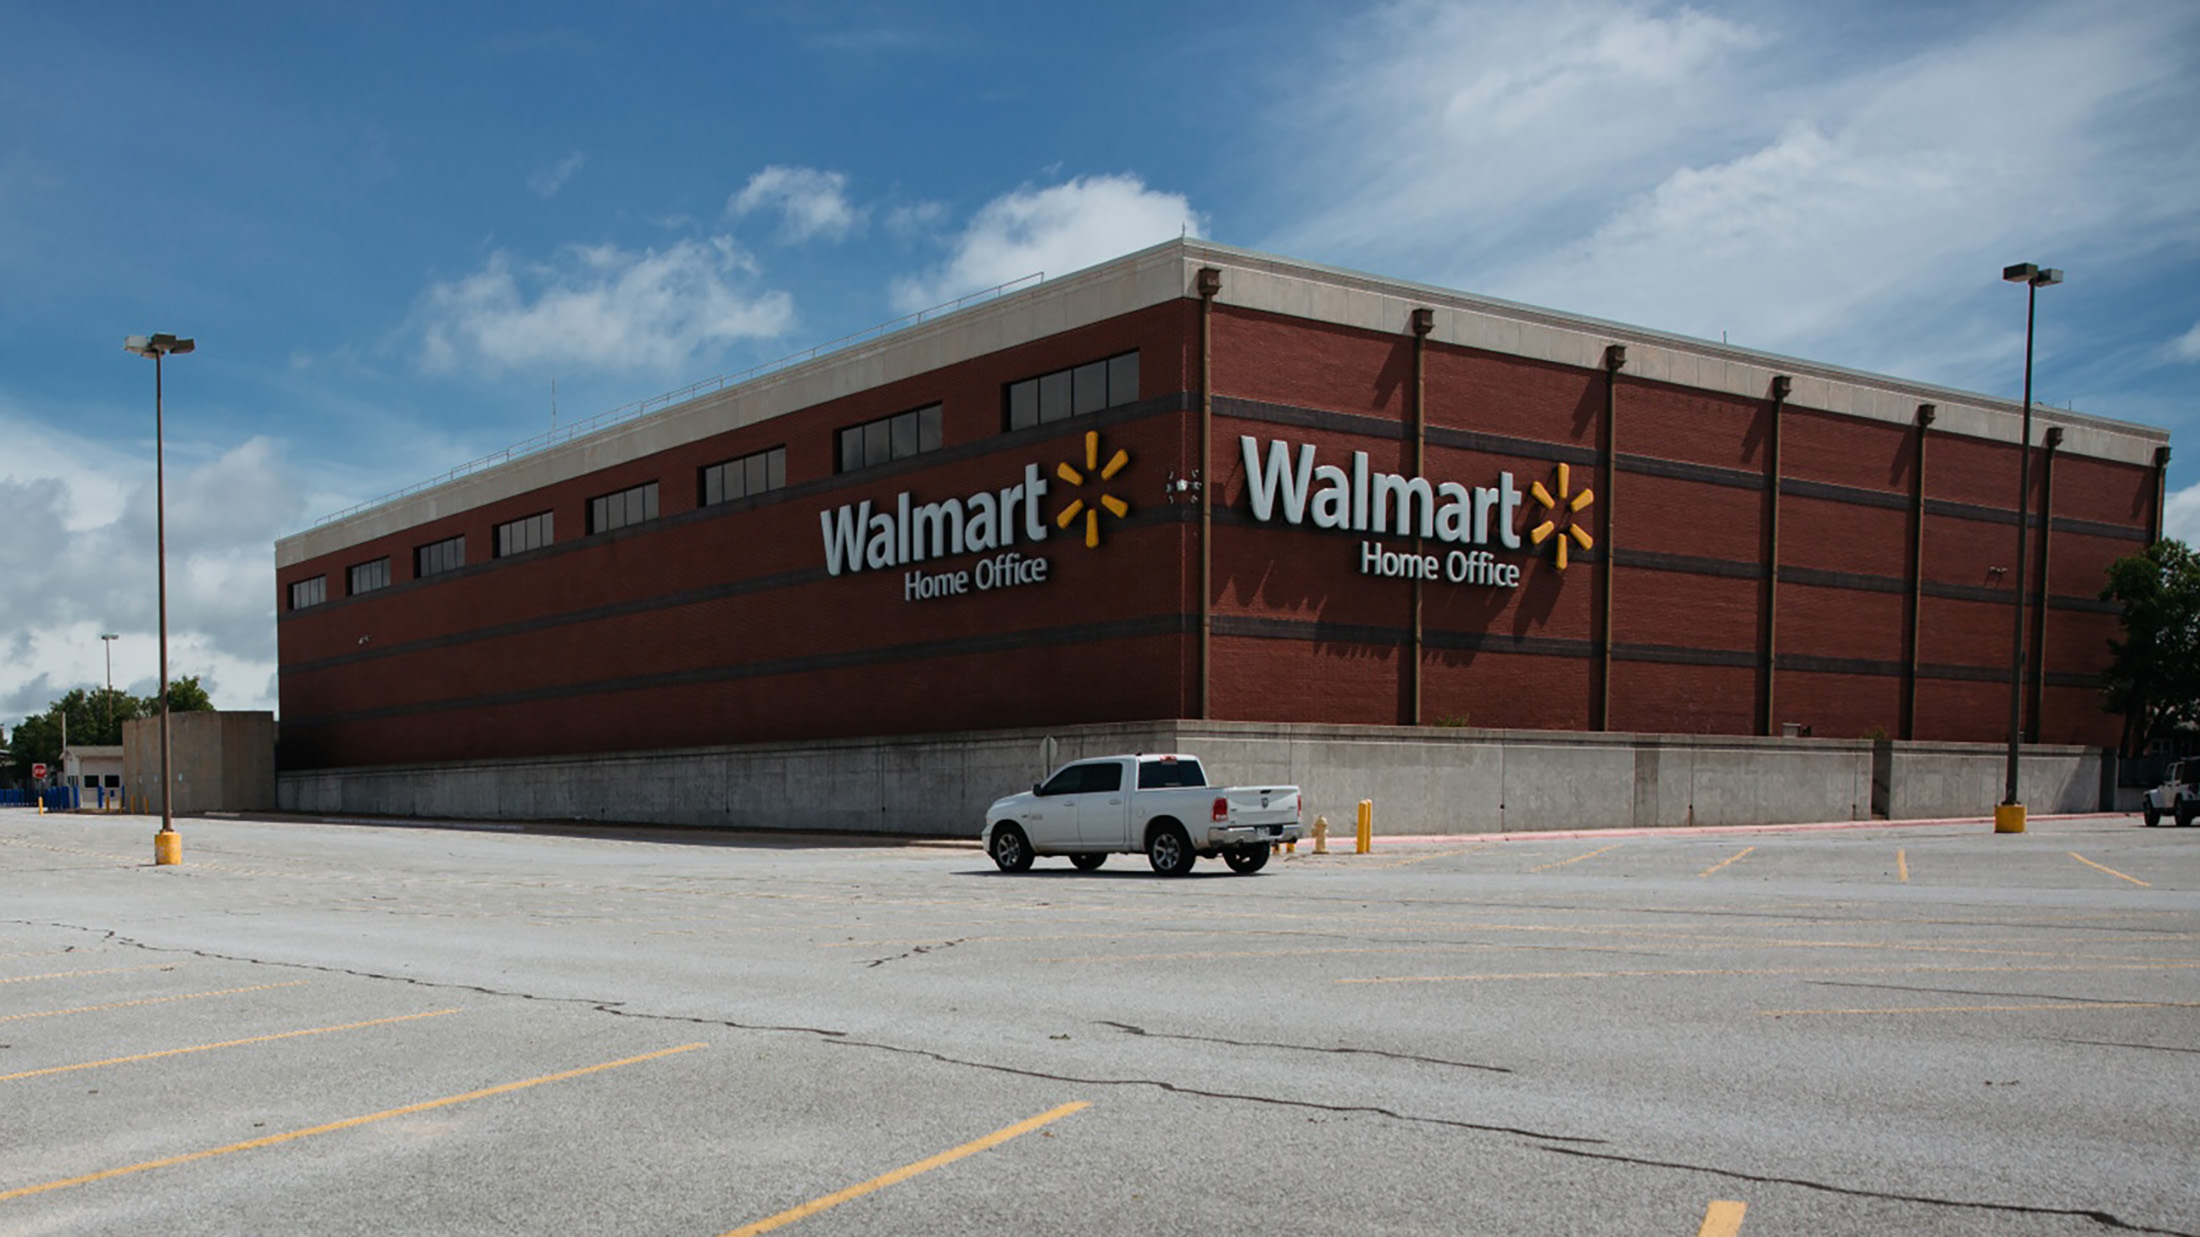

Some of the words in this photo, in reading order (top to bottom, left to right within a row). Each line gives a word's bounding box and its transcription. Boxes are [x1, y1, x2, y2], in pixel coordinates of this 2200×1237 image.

[820, 463, 1047, 576] Walmart
[1240, 435, 1522, 549] Walmart
[904, 570, 968, 601] Home
[975, 552, 1047, 590] Office
[1361, 541, 1438, 580] Home
[1446, 551, 1520, 588] Office
